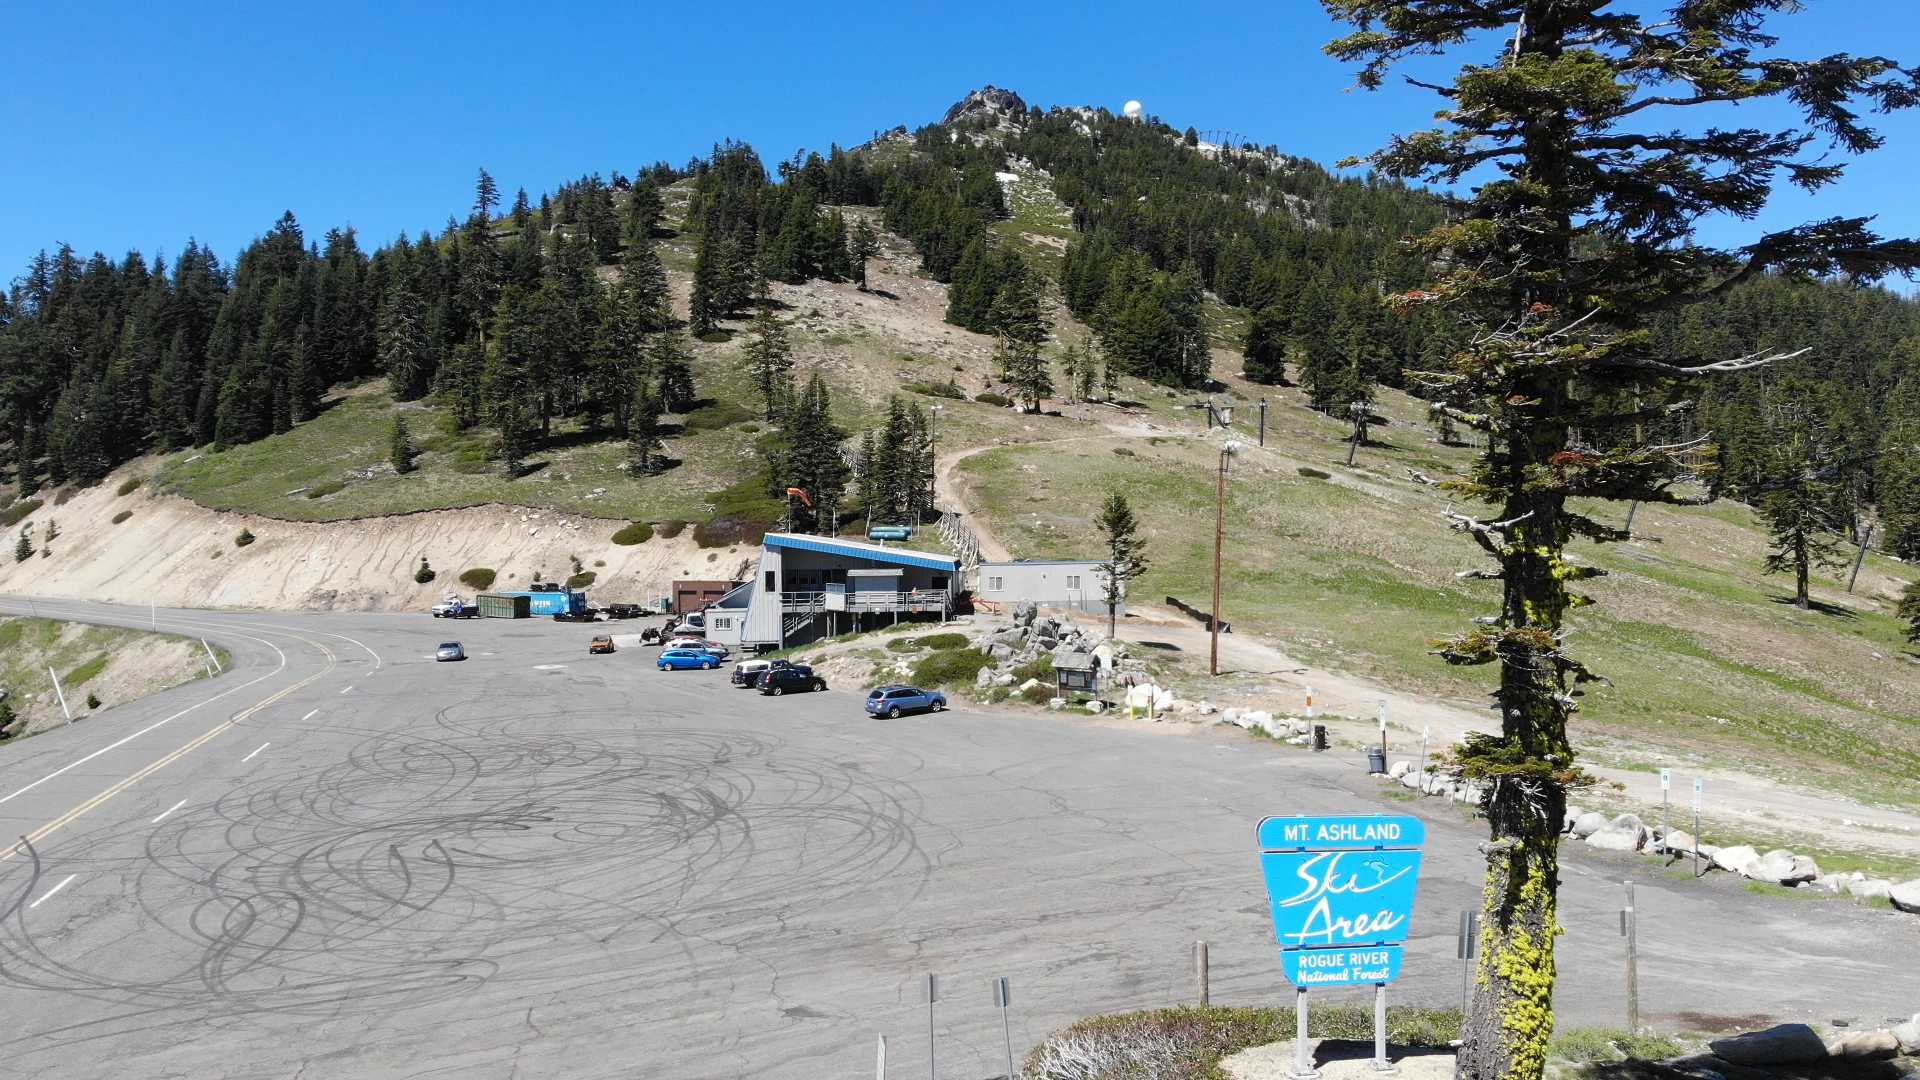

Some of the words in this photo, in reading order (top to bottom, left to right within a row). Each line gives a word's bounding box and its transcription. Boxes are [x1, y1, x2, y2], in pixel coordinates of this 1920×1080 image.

[1284, 824, 1311, 841] MT.
[1316, 823, 1401, 840] ASHLAND
[1279, 851, 1413, 908] Ski
[1284, 896, 1405, 945] Area
[1300, 954, 1345, 967] ROGUE
[1350, 952, 1389, 964] RIVER
[1297, 968, 1349, 983] National
[1352, 966, 1391, 980] Forest
